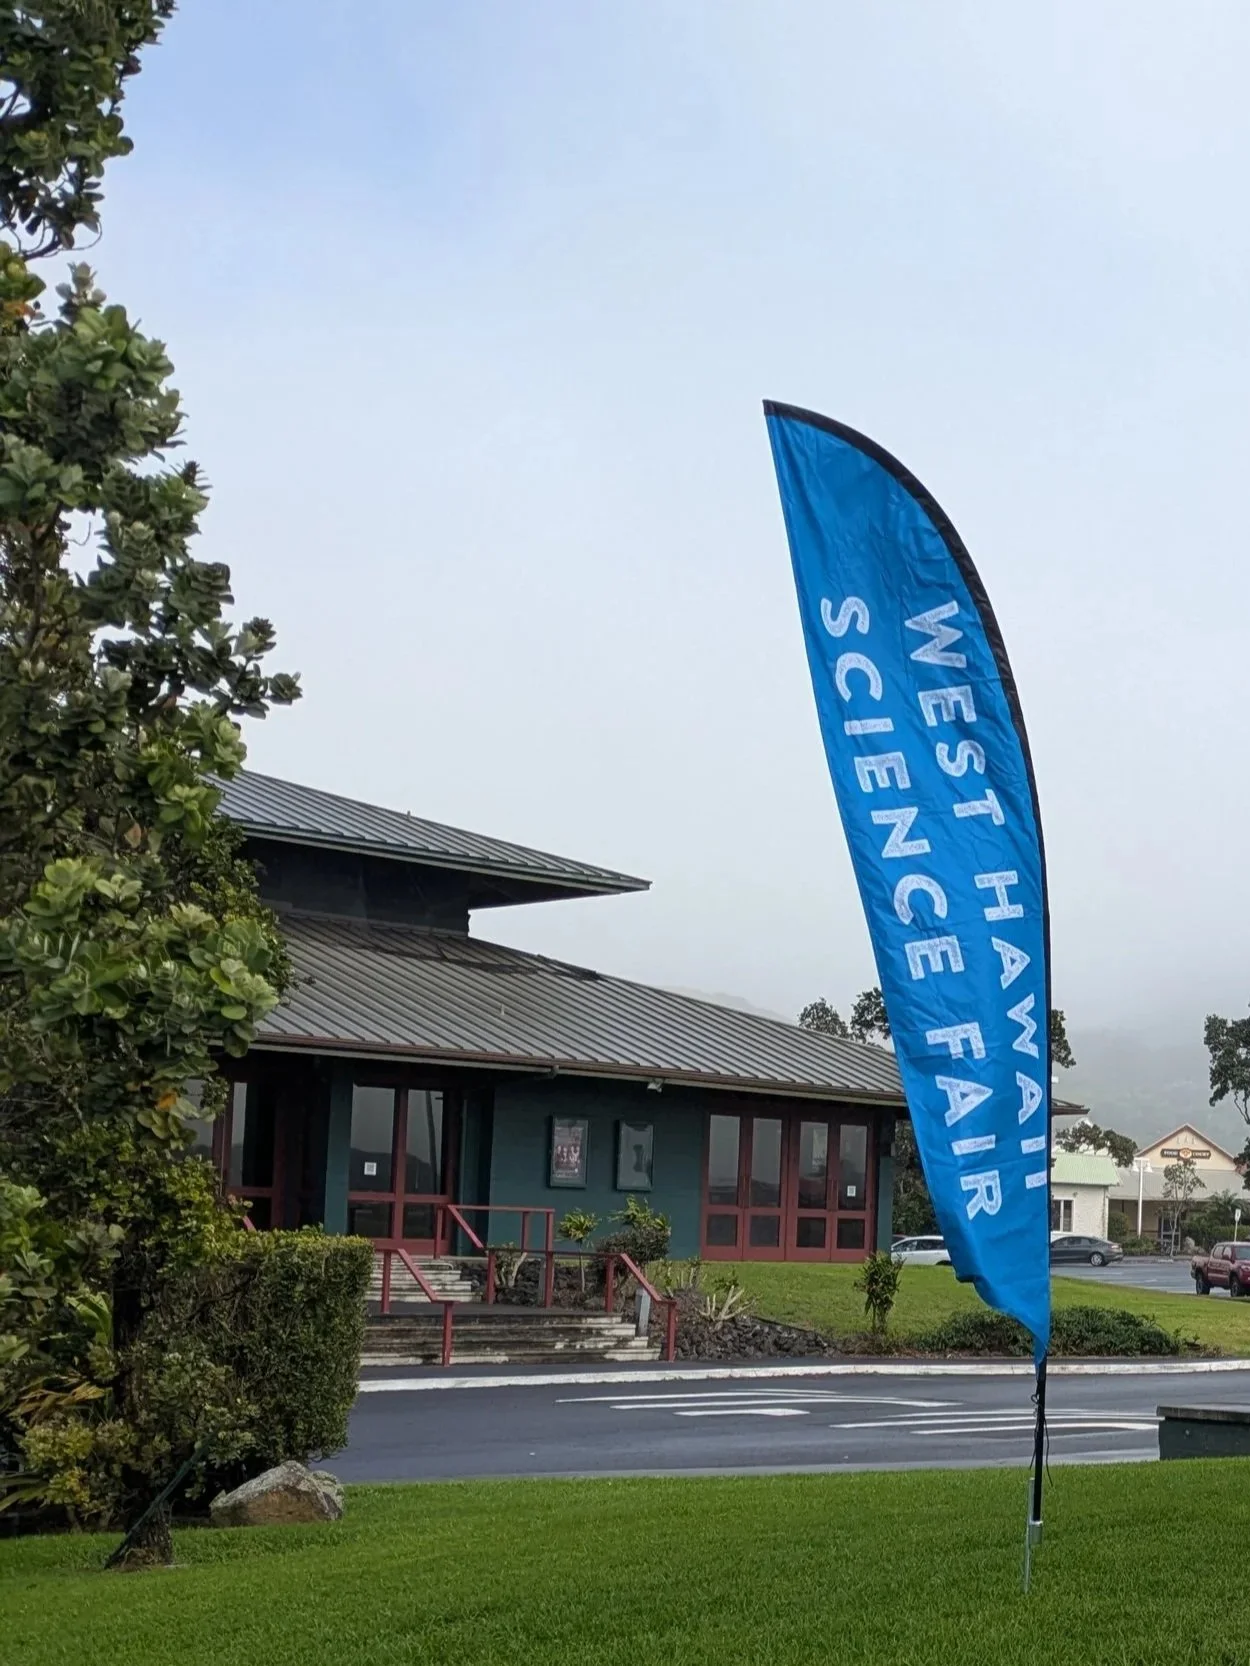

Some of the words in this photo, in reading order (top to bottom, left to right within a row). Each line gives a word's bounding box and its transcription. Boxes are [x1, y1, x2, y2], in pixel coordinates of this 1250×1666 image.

[820, 596, 965, 981] SCIENCE
[925, 1021, 1002, 1220] FAIR
[905, 600, 1005, 826] WEST
[973, 870, 1047, 1190] HAWAII
